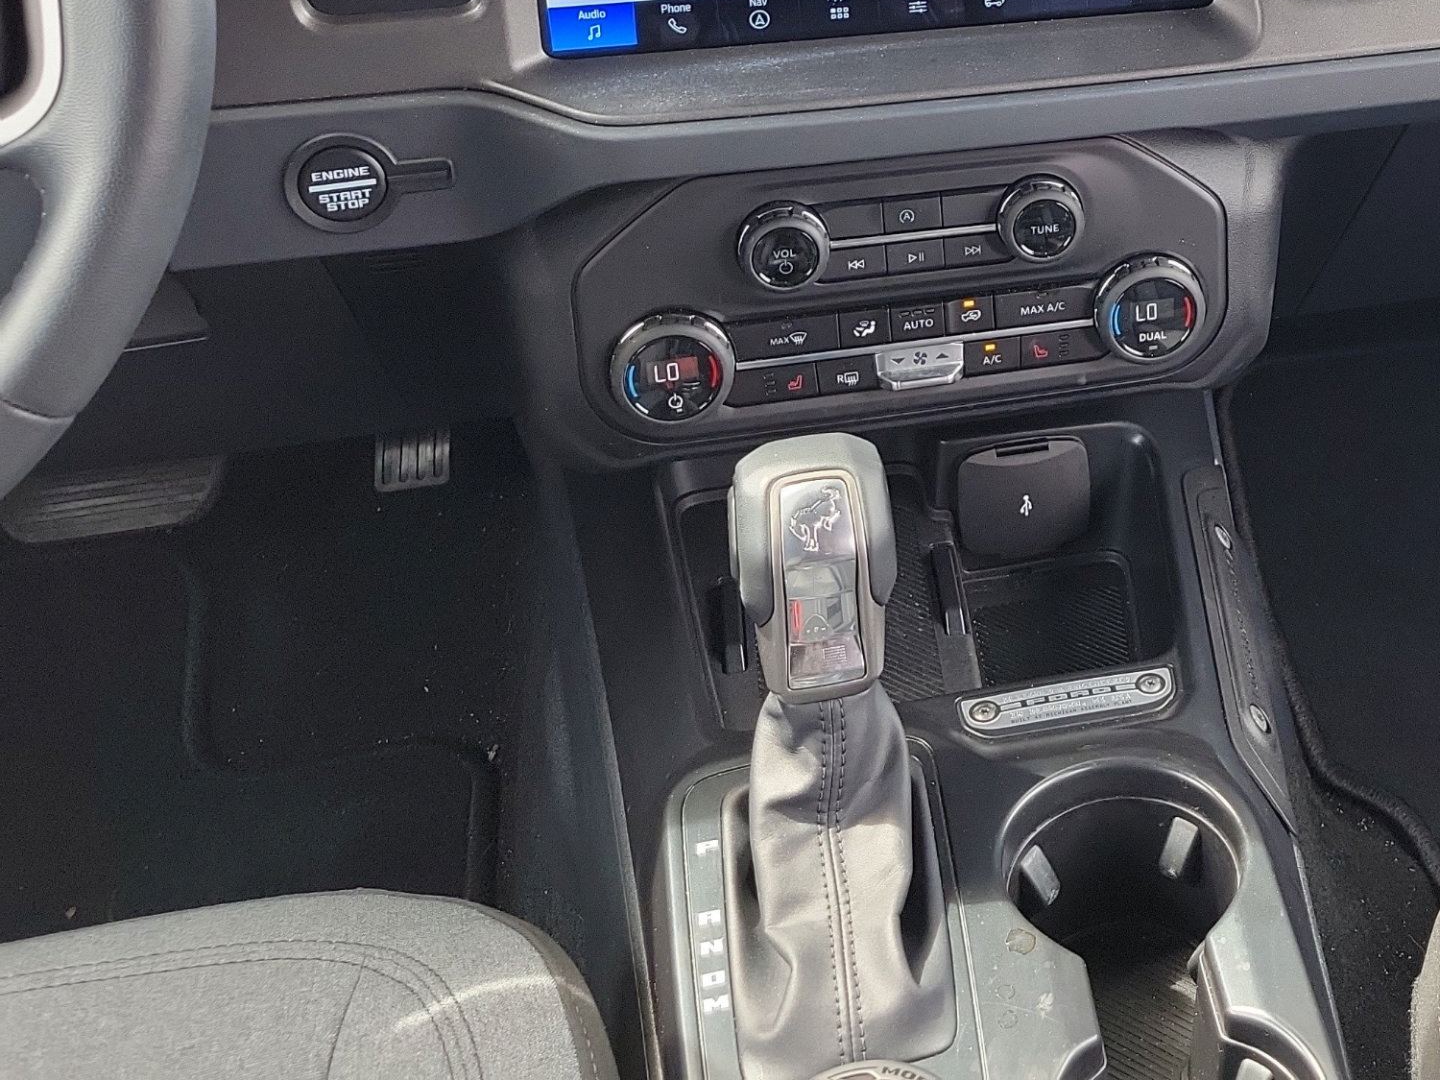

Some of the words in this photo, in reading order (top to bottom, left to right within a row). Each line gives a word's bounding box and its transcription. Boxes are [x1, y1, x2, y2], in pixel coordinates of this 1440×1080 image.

[578, 9, 607, 20] Audio
[660, 3, 692, 14] Phone
[311, 166, 370, 182] ENGINE
[318, 188, 373, 204] START
[326, 198, 370, 212] STOP
[1030, 224, 1060, 235] TUNE
[773, 249, 797, 259] VOL
[1020, 305, 1044, 316] MAX
[1046, 302, 1066, 313] A/C
[1135, 302, 1159, 321] LO
[903, 318, 934, 331] AUTO
[770, 336, 790, 347] MAX
[1139, 330, 1167, 342] DUAL
[983, 353, 1002, 366] A/C
[654, 361, 680, 383] LO
[837, 375, 844, 384] R
[696, 839, 719, 856] P
[700, 937, 724, 955] N
[703, 994, 730, 1014] M
